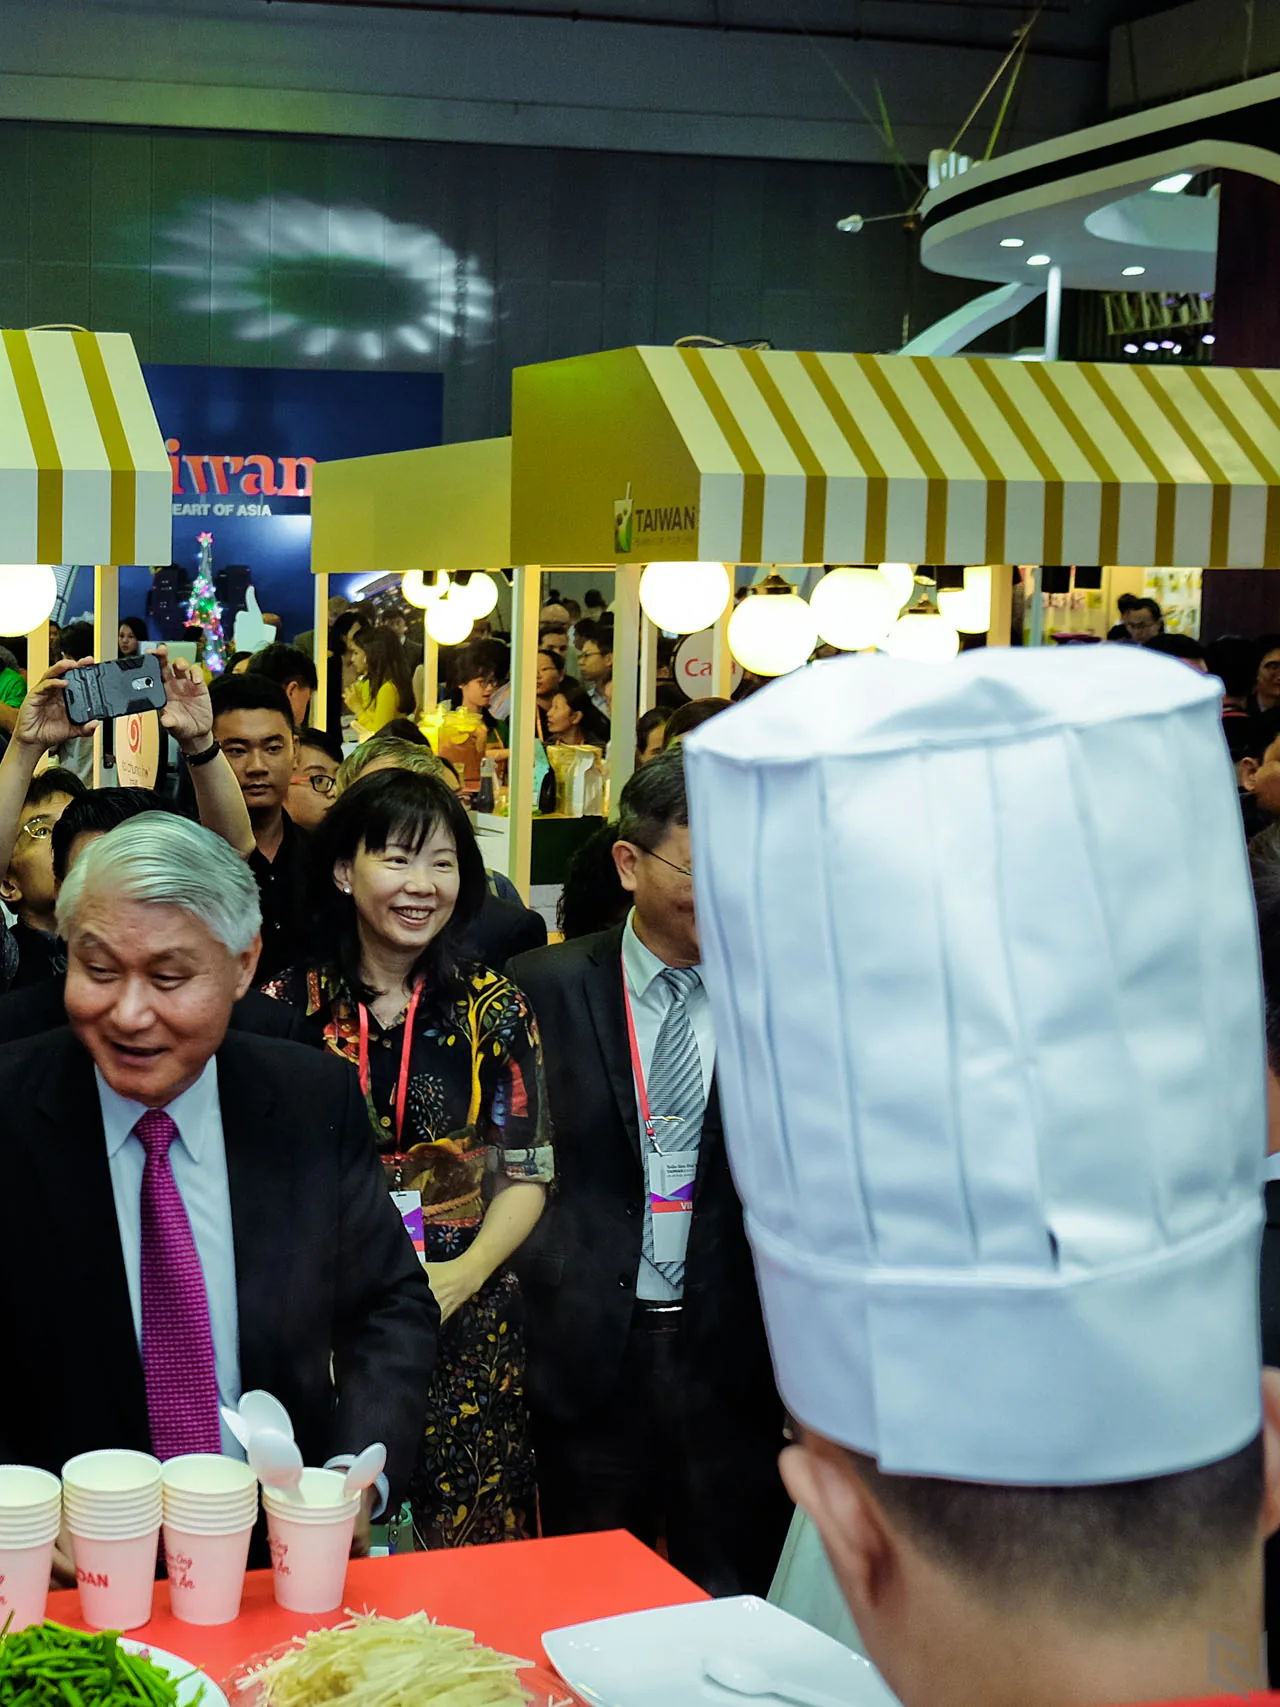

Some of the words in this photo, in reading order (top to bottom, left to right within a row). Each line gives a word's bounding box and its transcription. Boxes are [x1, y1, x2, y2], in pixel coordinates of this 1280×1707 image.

[213, 504, 235, 516] OF
[236, 504, 272, 516] ASIA
[635, 506, 697, 532] TAIWAN
